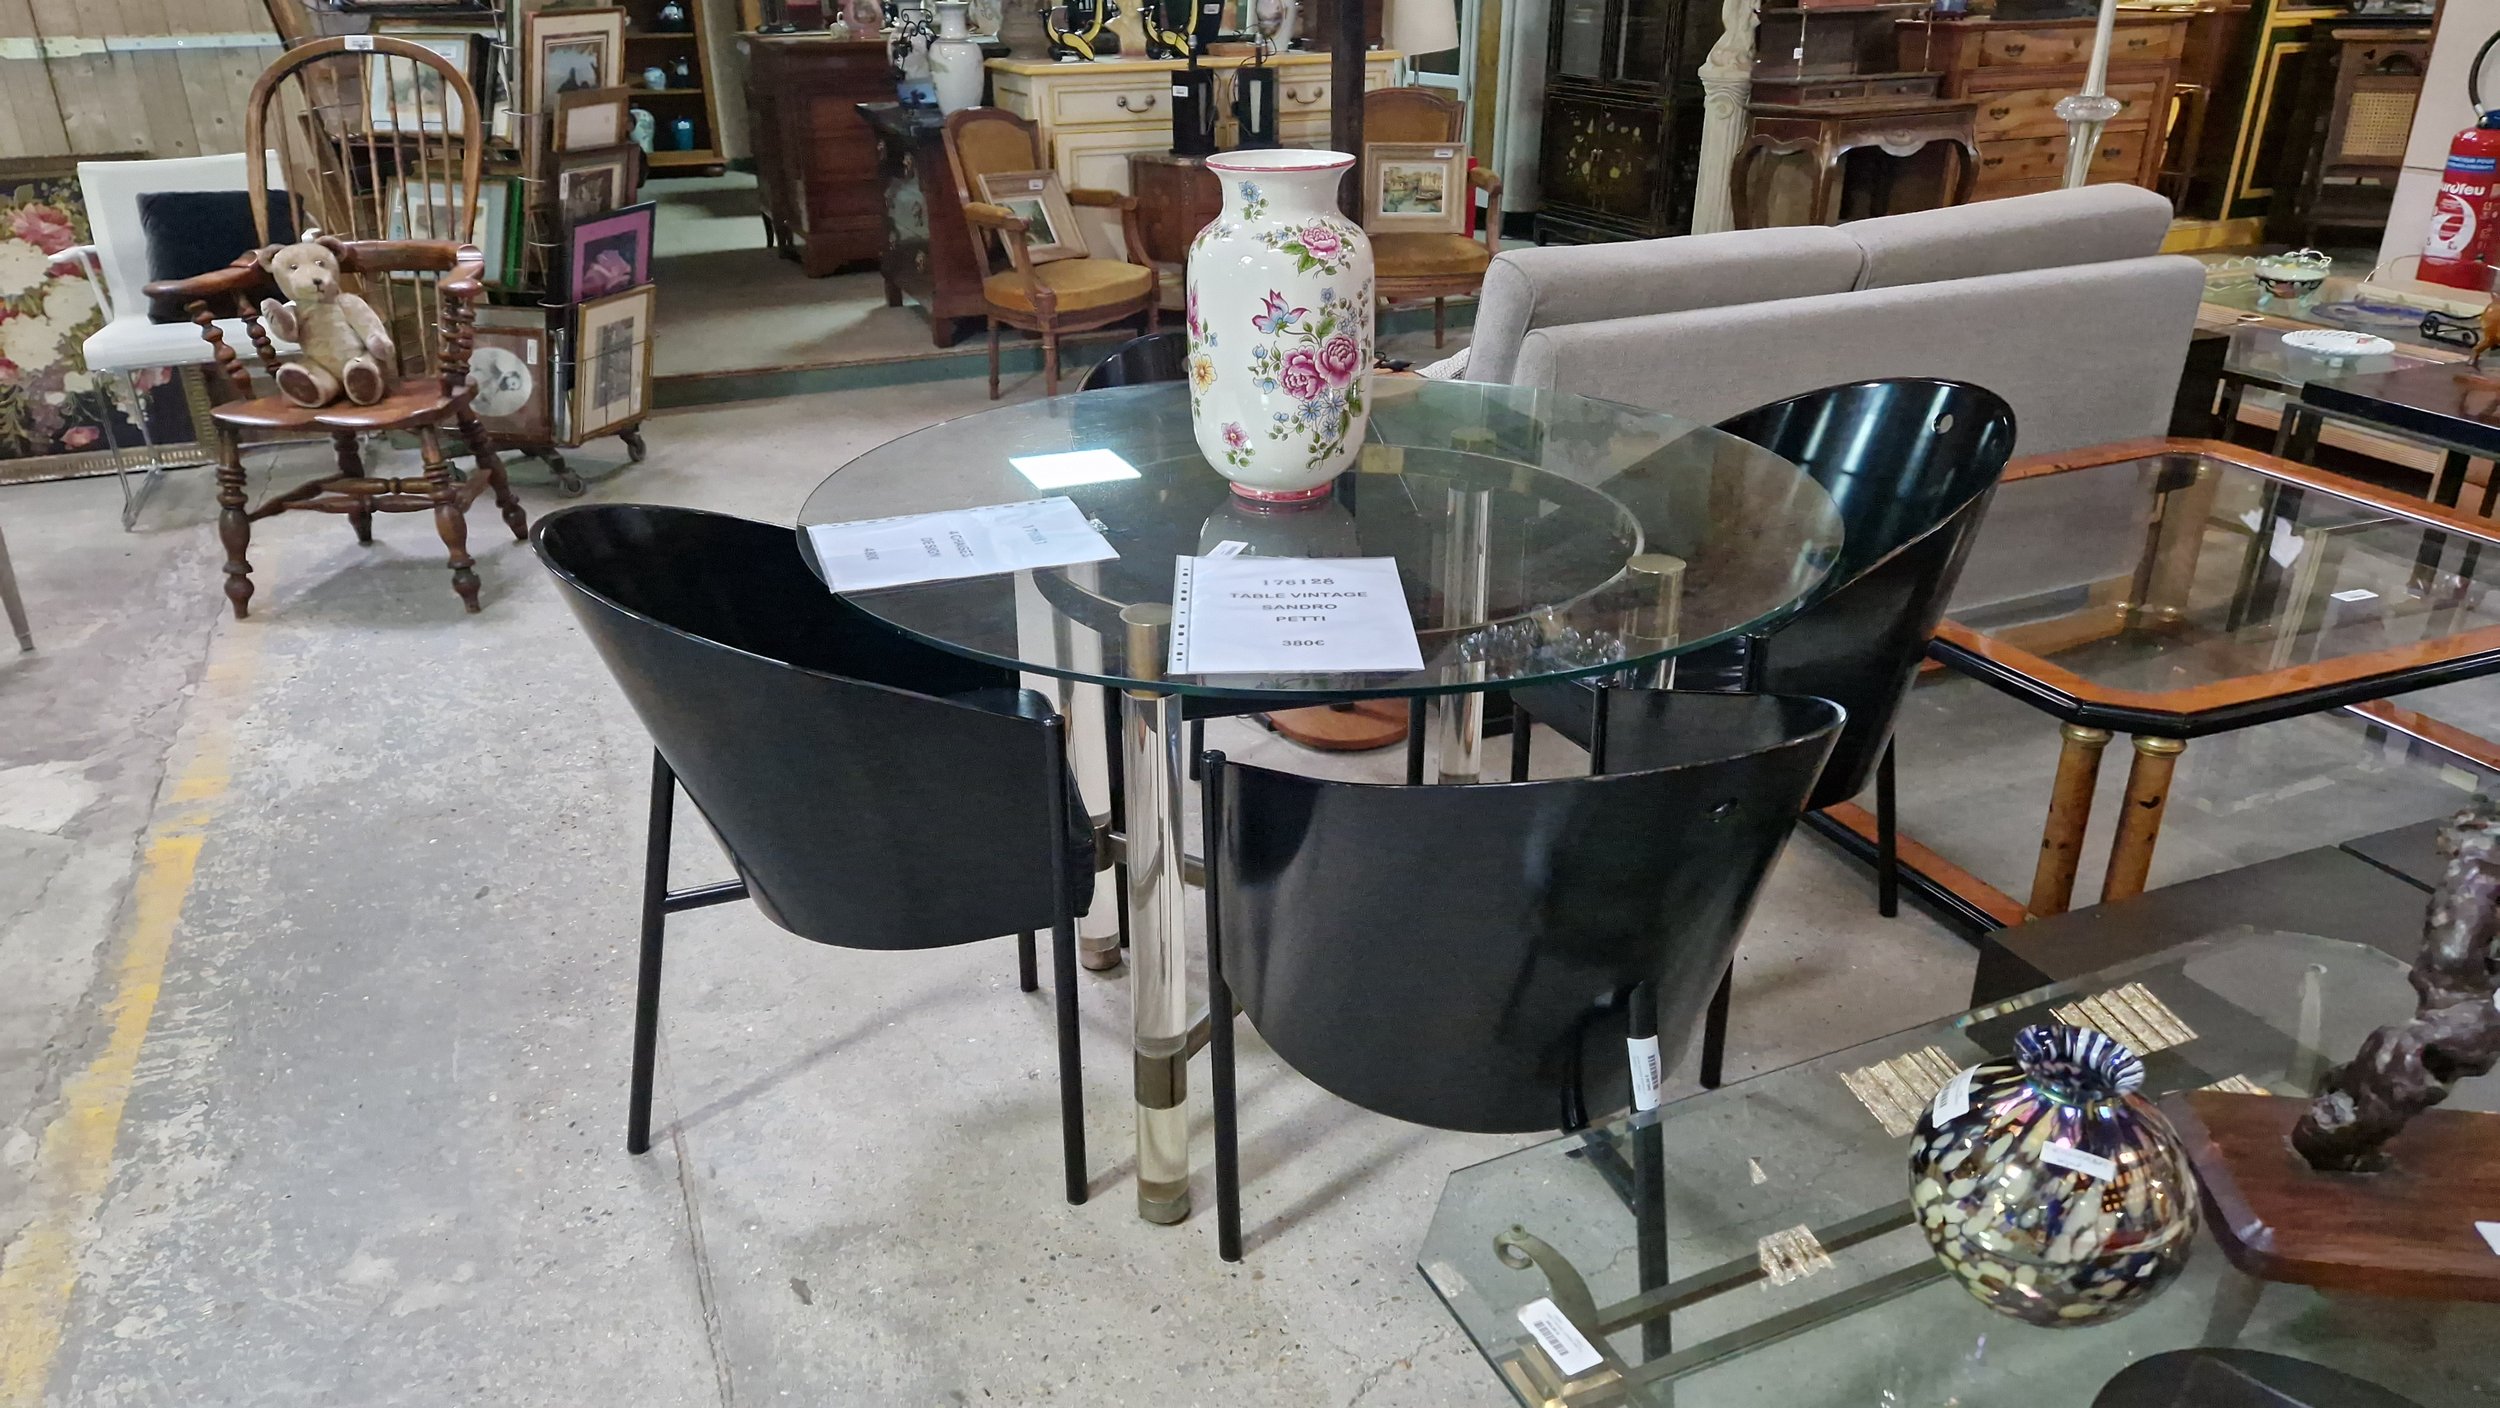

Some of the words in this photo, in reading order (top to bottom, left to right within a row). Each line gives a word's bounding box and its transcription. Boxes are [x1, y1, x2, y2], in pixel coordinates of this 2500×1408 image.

[2441, 182, 2486, 196] urofeu
[920, 537, 941, 557] DESIGN
[951, 534, 974, 558] CHAISES
[1264, 577, 1335, 586] 176128
[1230, 592, 1285, 600] TABLE
[1290, 591, 1367, 599] VINTAGE
[1282, 639, 1325, 647] 380€
